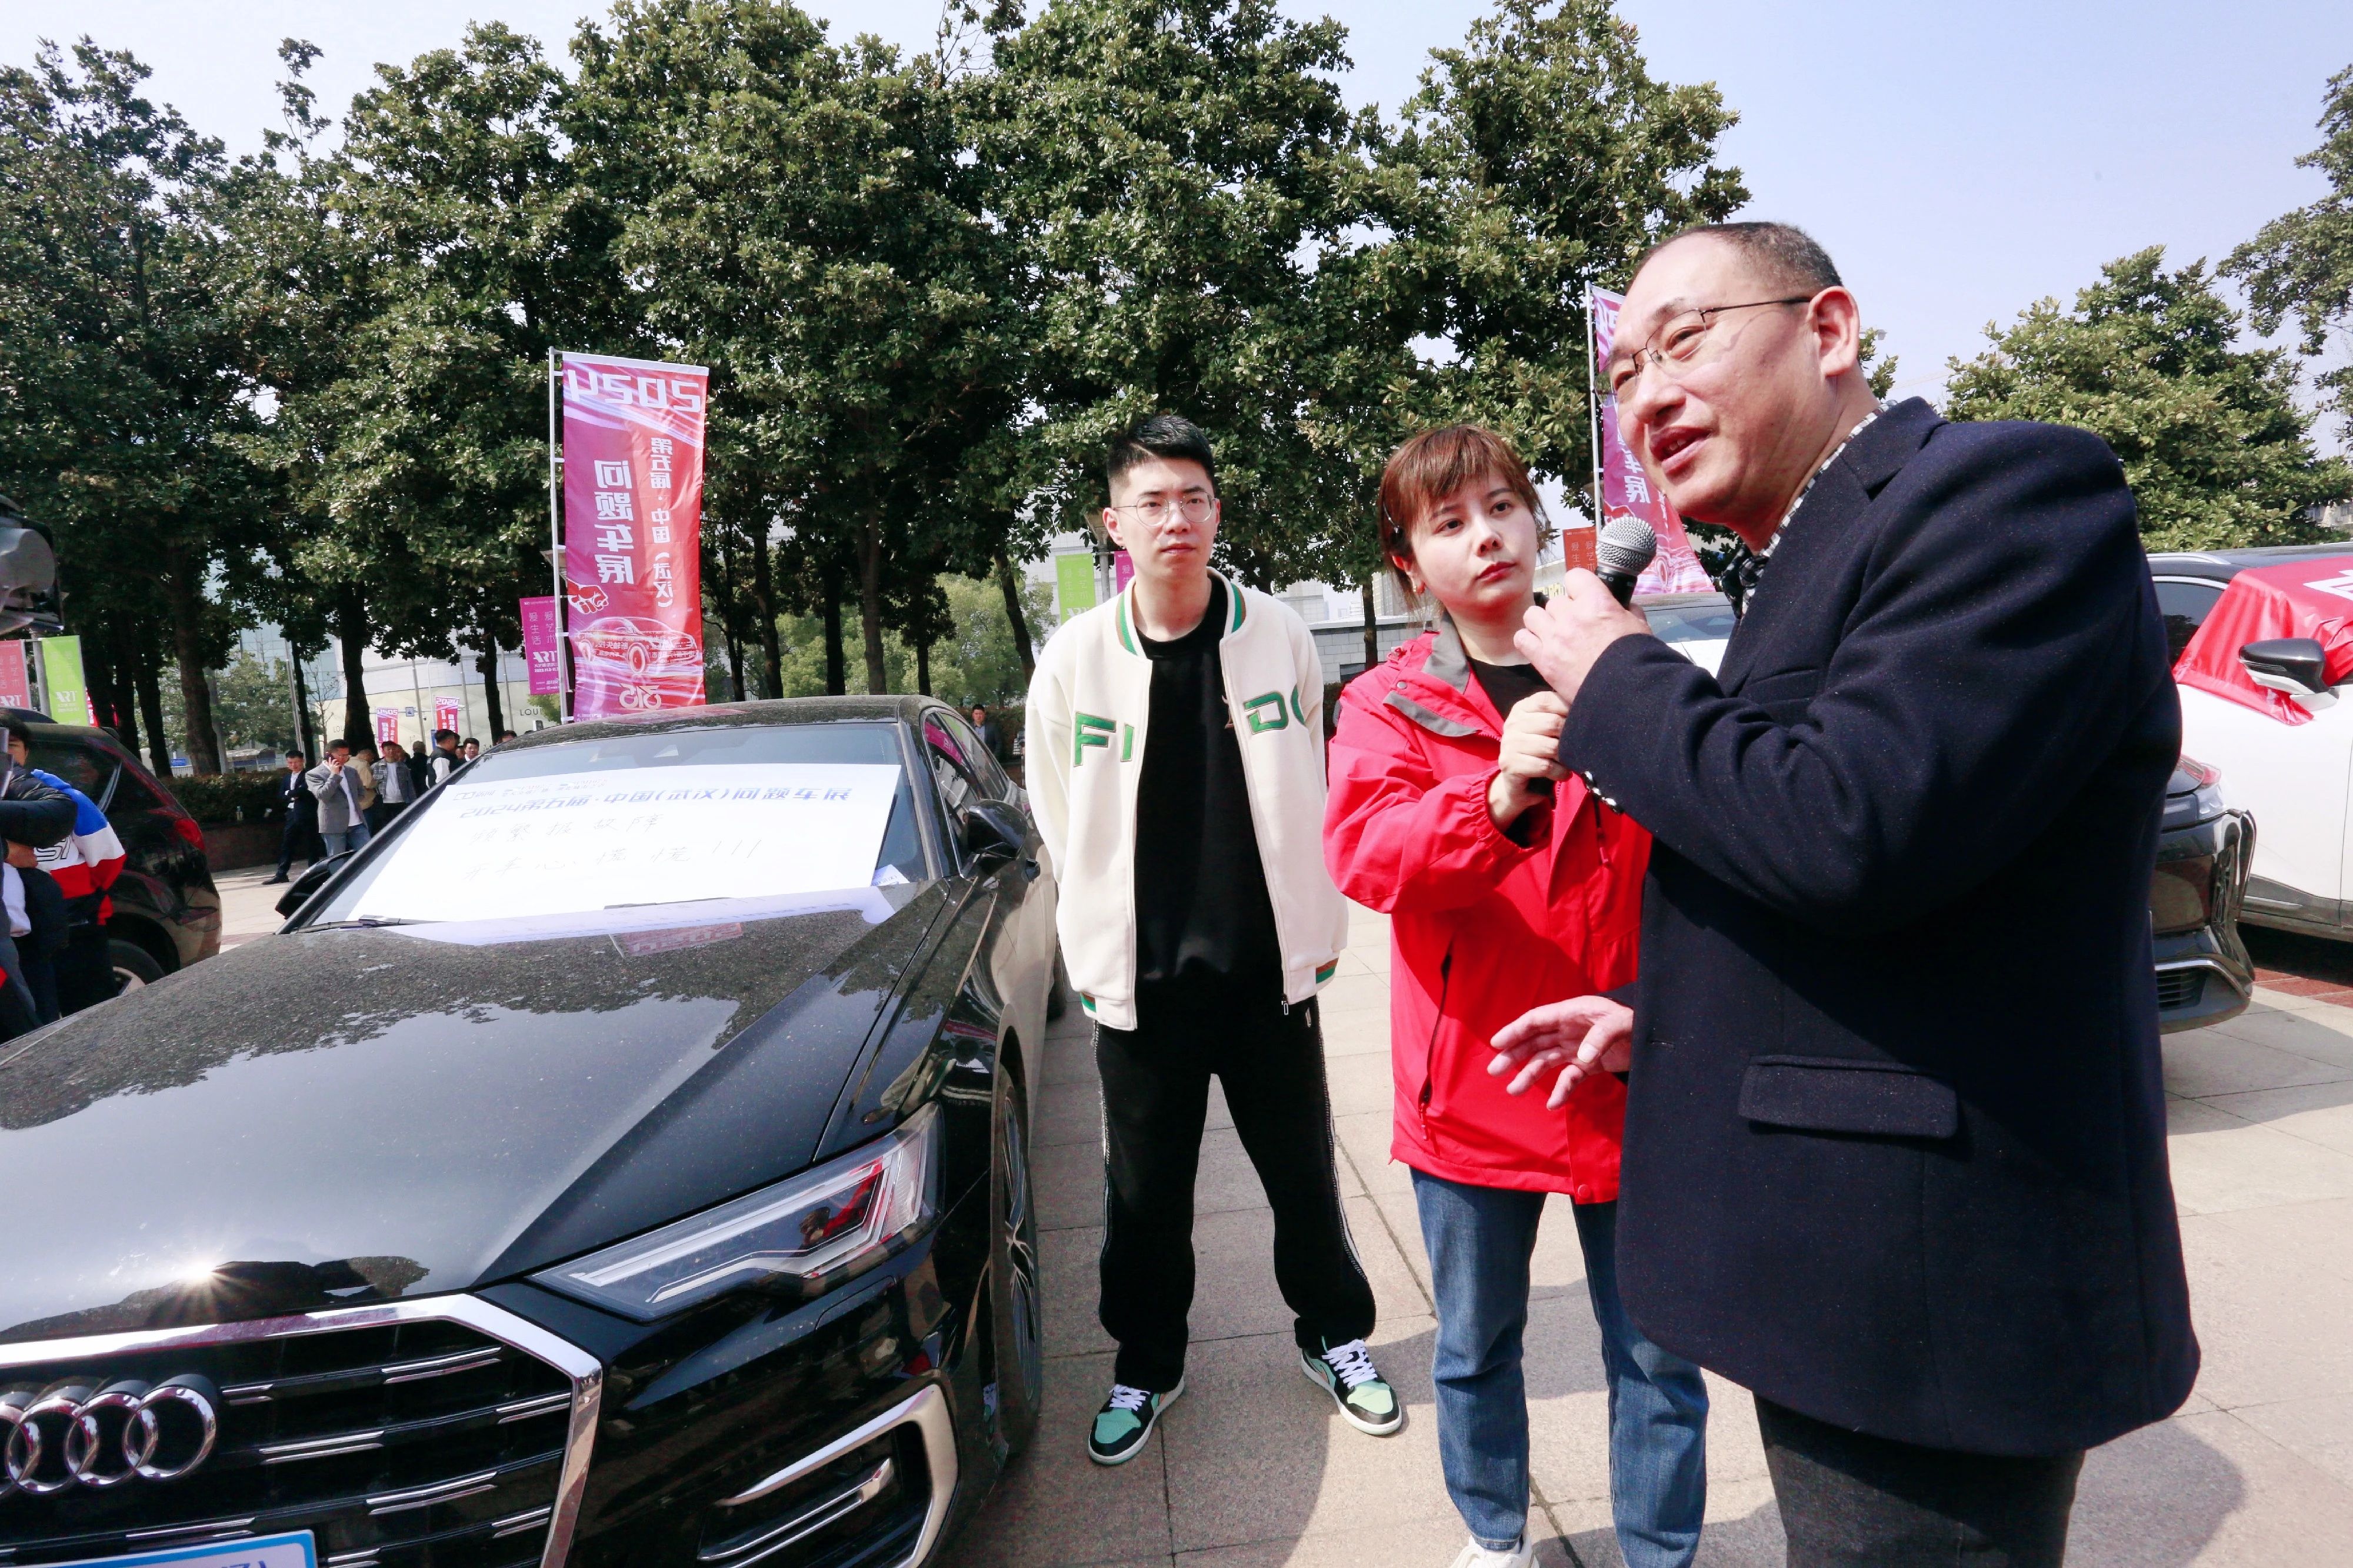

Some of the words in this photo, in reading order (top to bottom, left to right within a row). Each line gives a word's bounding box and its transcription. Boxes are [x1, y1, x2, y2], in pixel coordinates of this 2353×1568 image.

[1571, 542, 1581, 568] 爱生
[529, 612, 541, 645] 爱生活
[544, 611, 555, 644] 爱艺术
[532, 651, 557, 662] ART
[0, 695, 22, 706] ART
[55, 690, 77, 702] ART
